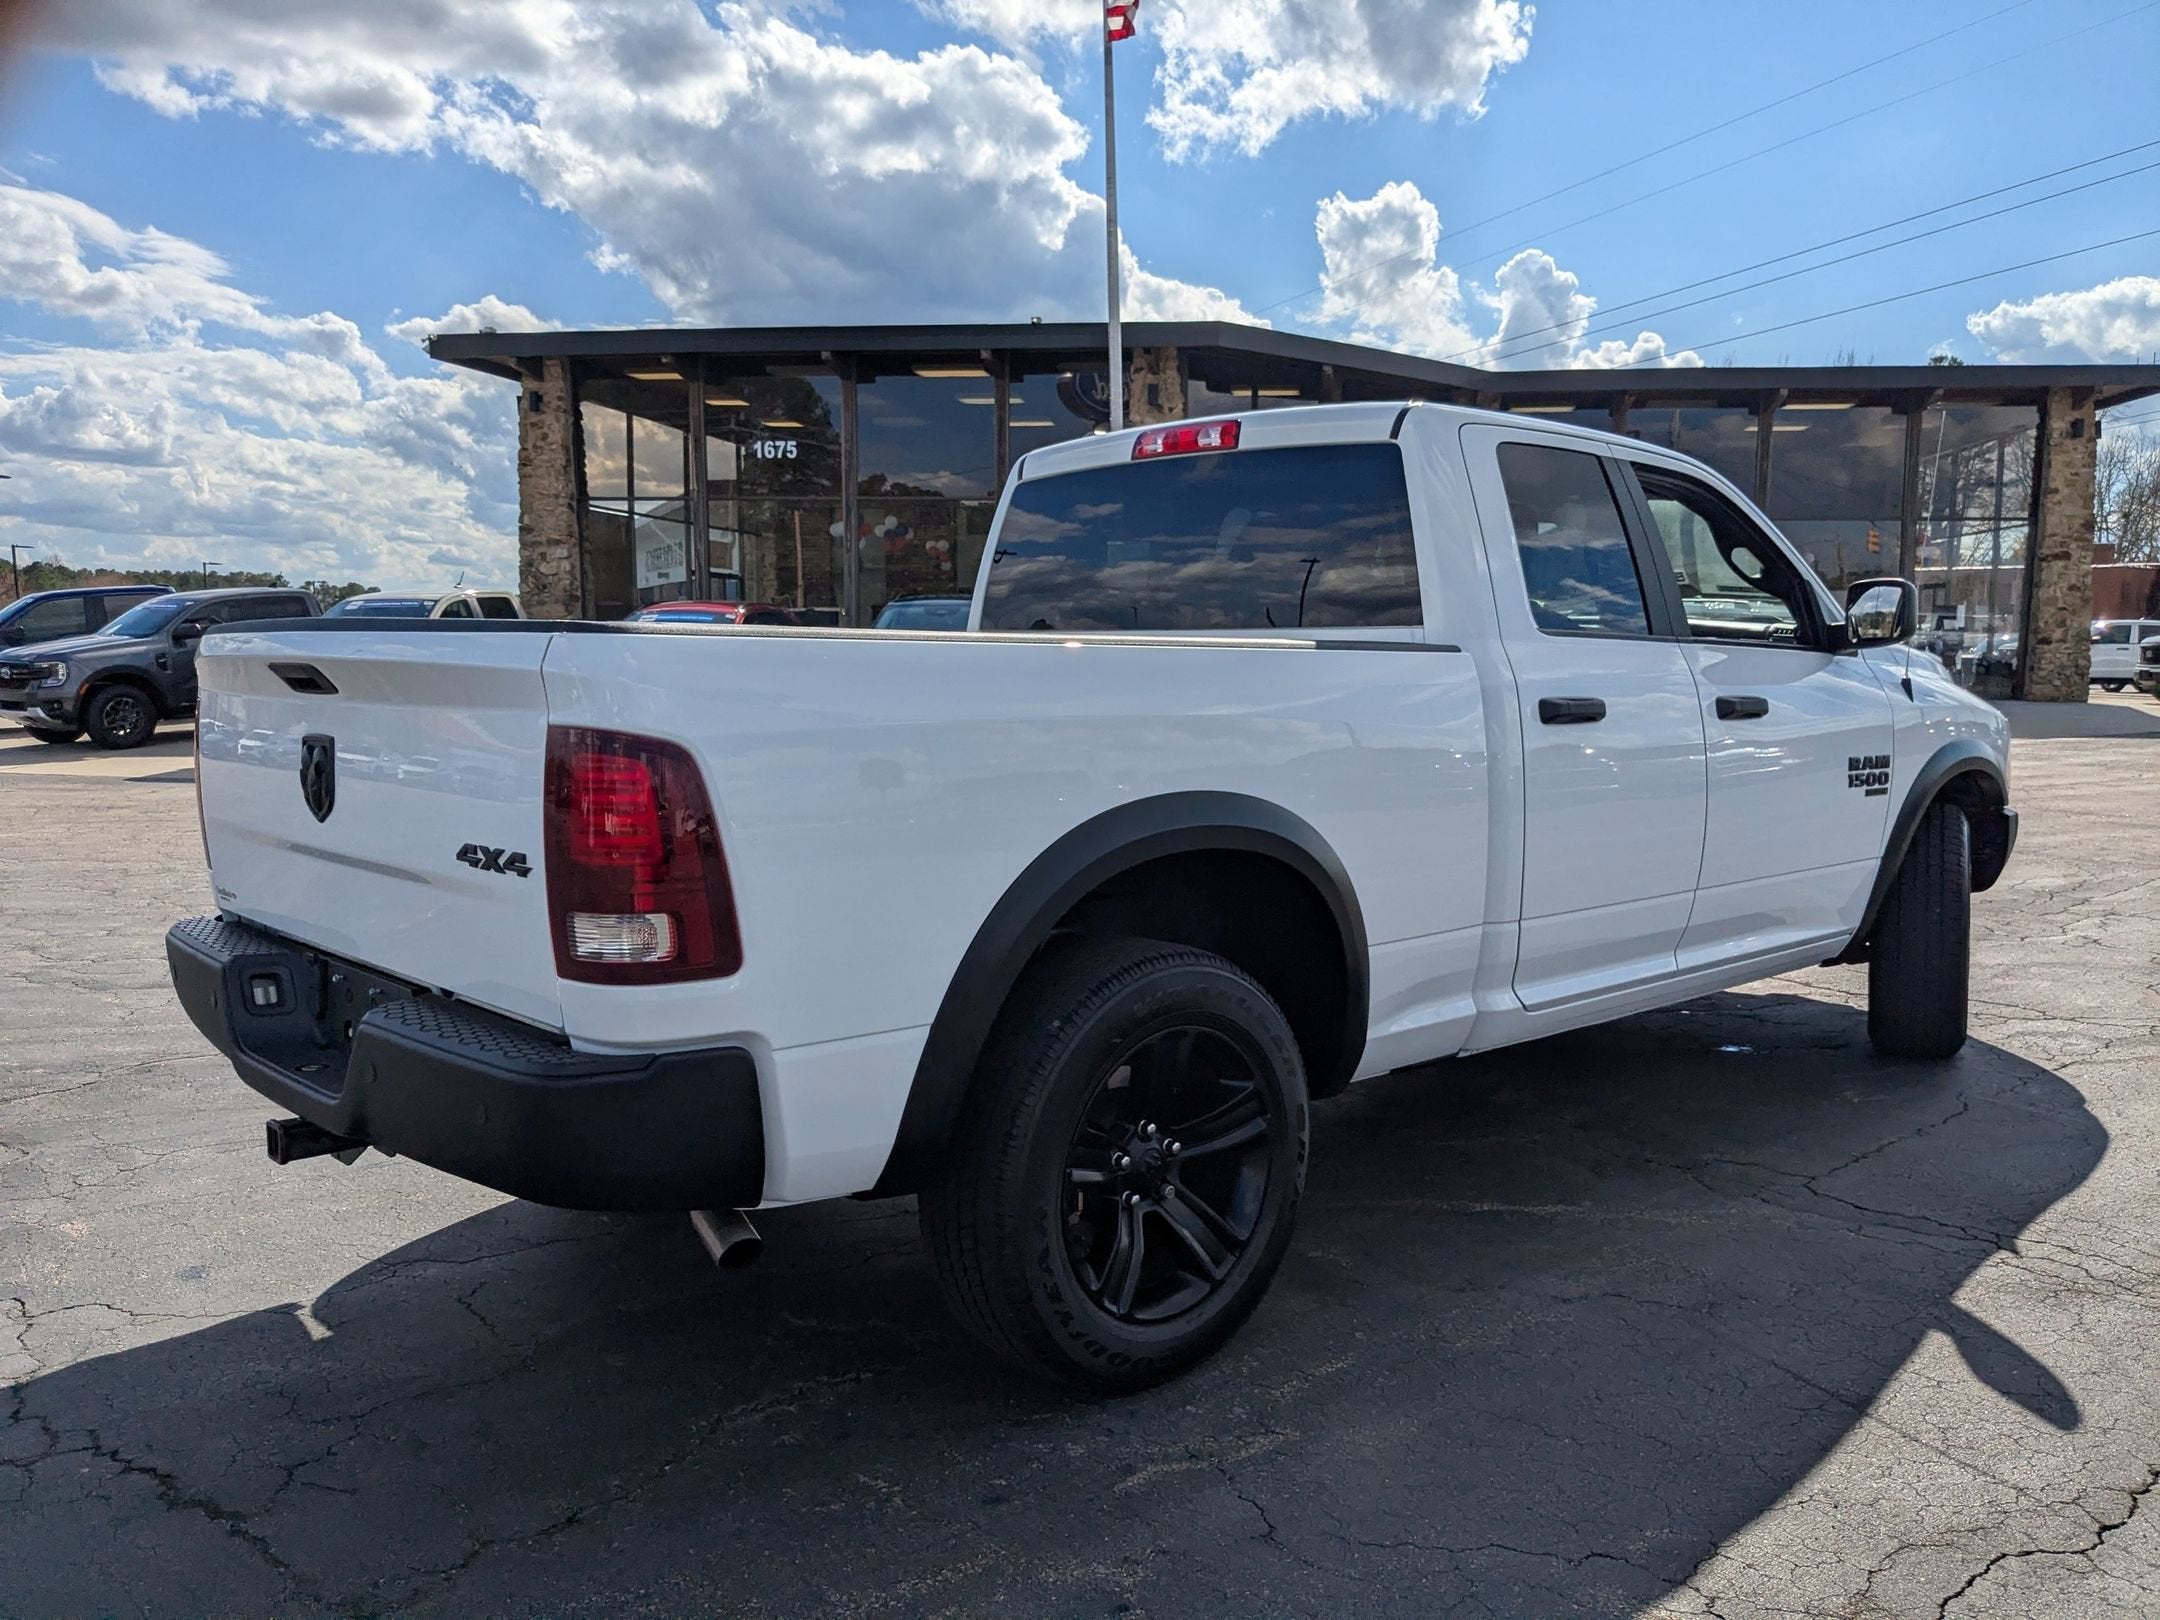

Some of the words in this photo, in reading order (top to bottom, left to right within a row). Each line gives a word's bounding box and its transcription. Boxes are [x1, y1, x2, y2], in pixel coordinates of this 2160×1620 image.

[754, 440, 798, 459] 1675
[1848, 755, 1891, 771] RAM
[1848, 771, 1890, 788] 1500
